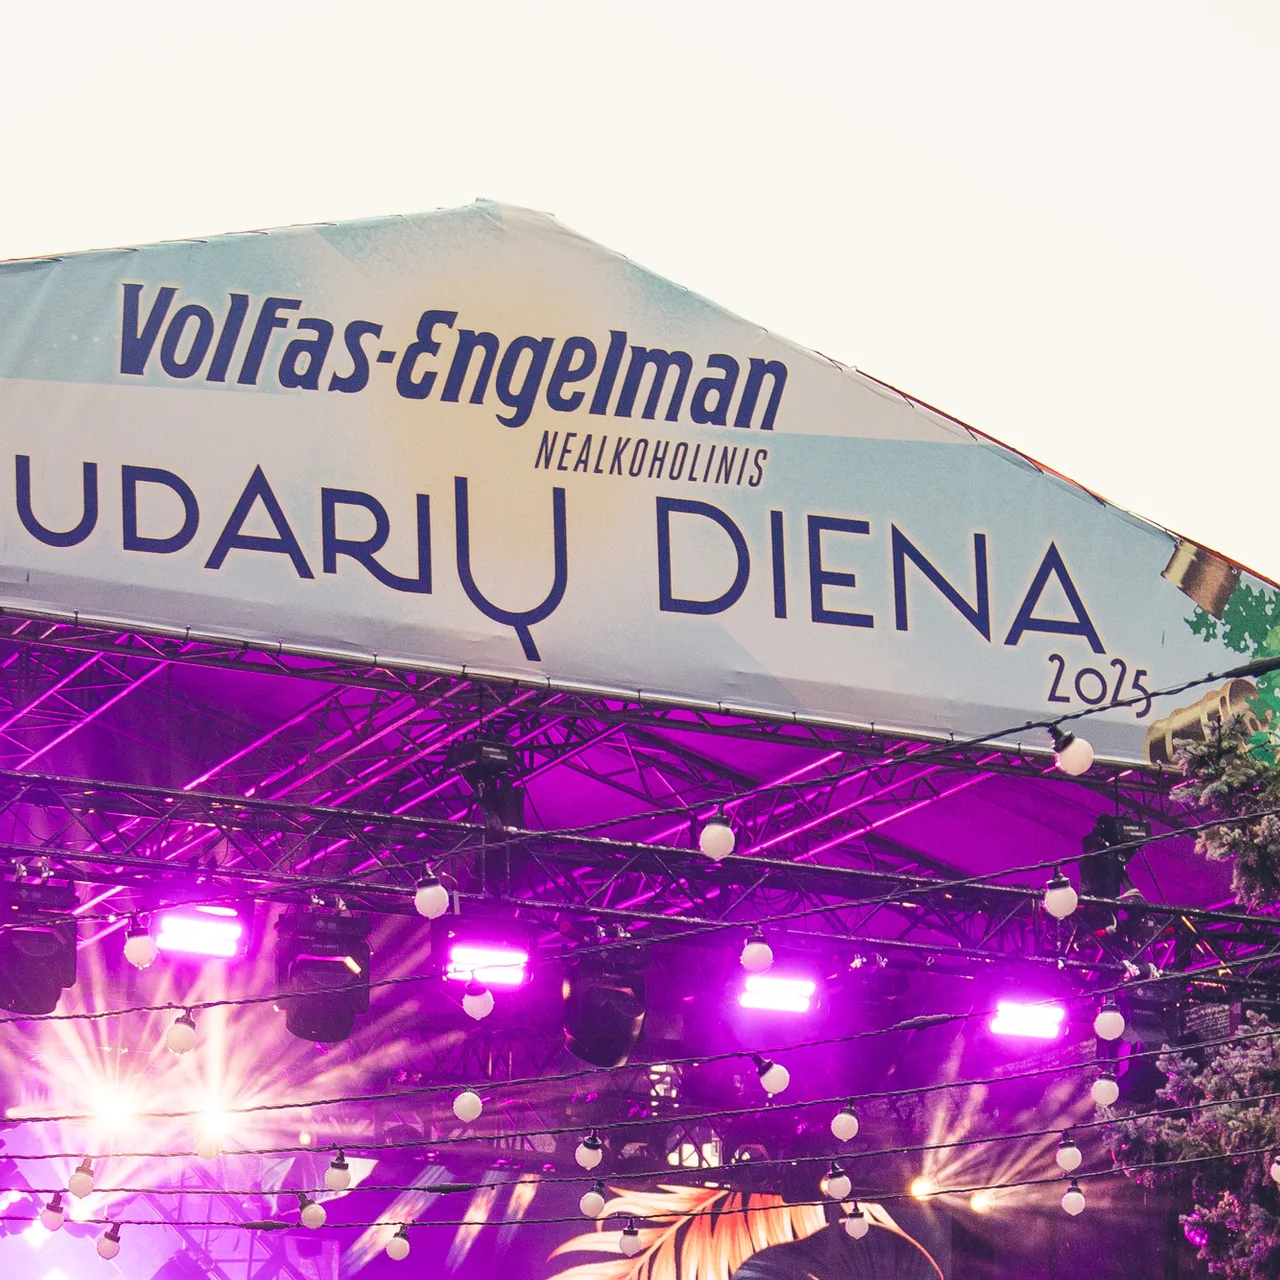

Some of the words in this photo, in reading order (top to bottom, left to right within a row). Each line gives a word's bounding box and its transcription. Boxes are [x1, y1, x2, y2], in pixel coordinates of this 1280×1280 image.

[120, 283, 788, 430] Volfas-Engelman
[534, 430, 769, 488] NEALKOHOLINIS
[656, 496, 1107, 654] DIENA
[1047, 653, 1152, 718] 2025
